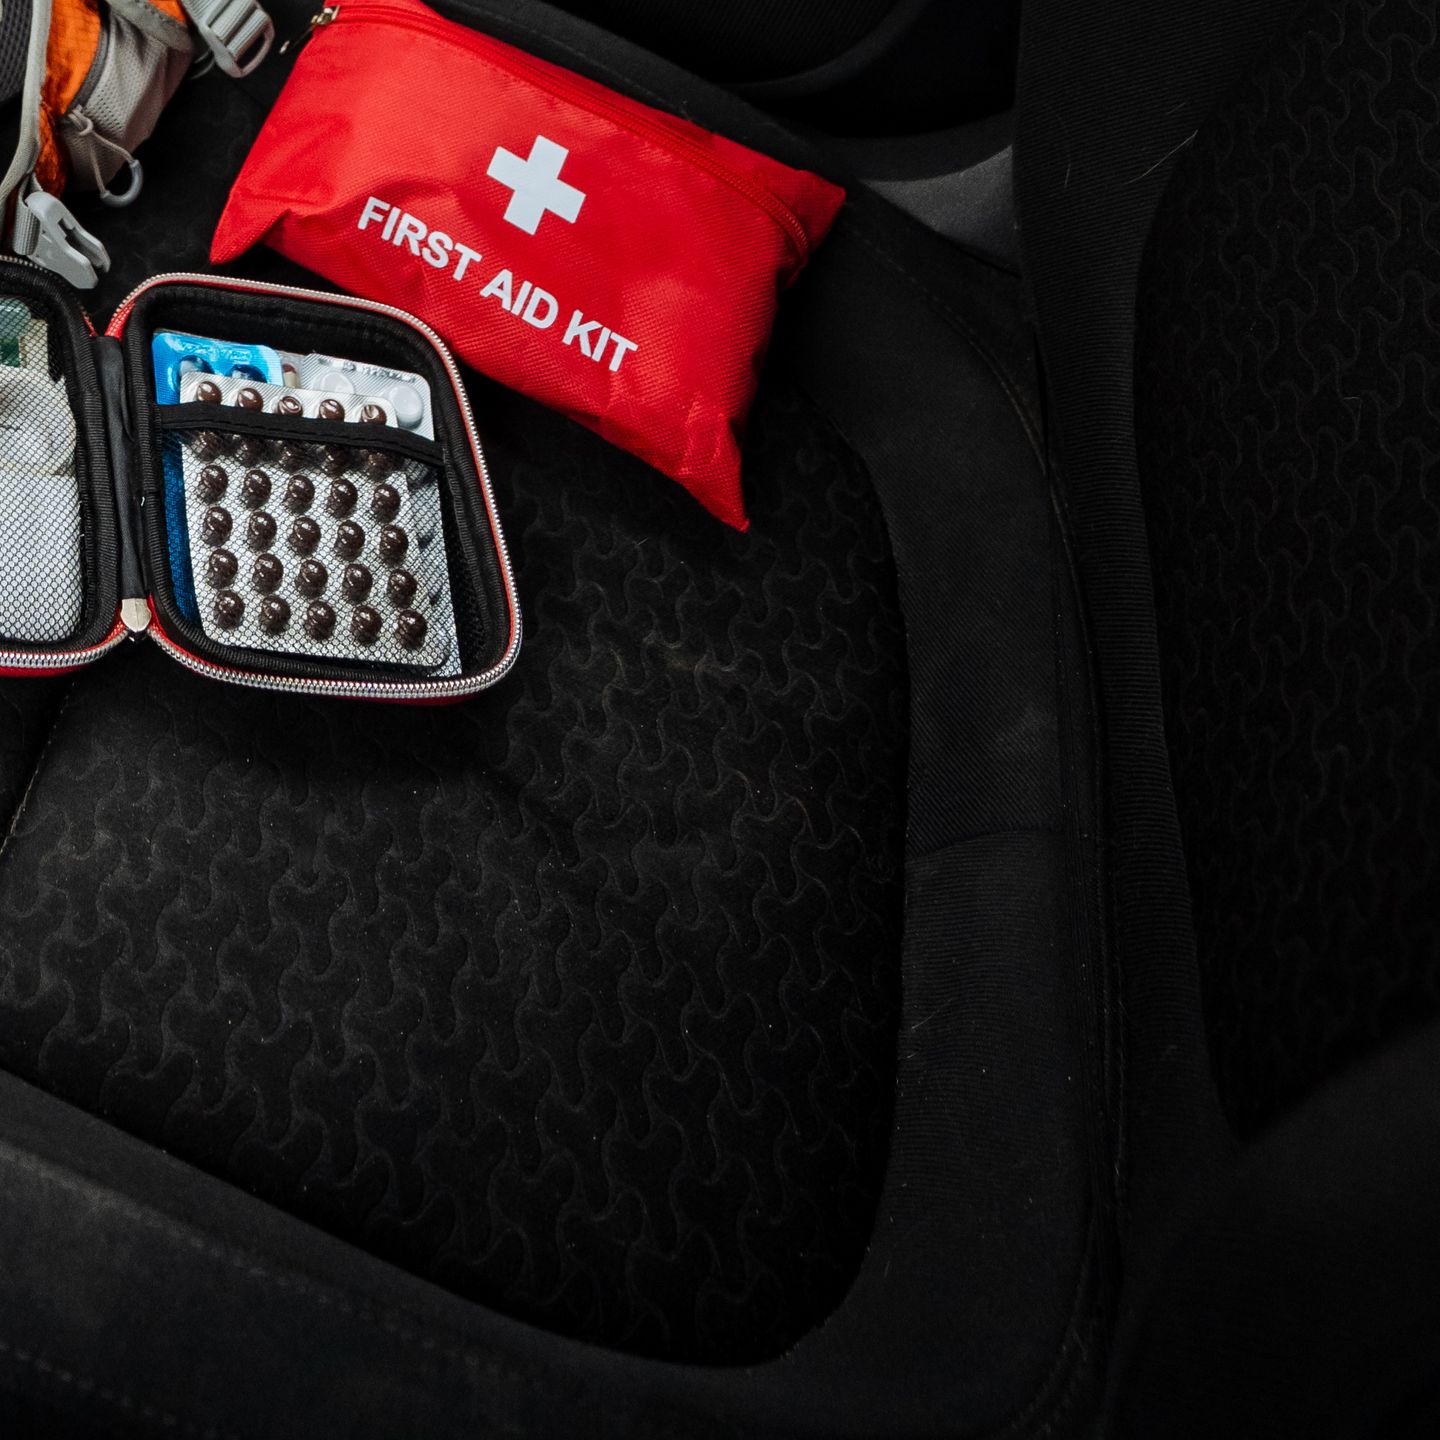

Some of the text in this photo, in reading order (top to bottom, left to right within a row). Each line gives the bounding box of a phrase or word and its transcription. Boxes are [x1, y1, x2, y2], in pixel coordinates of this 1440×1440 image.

[357, 196, 639, 372] FIRST AID KIT
